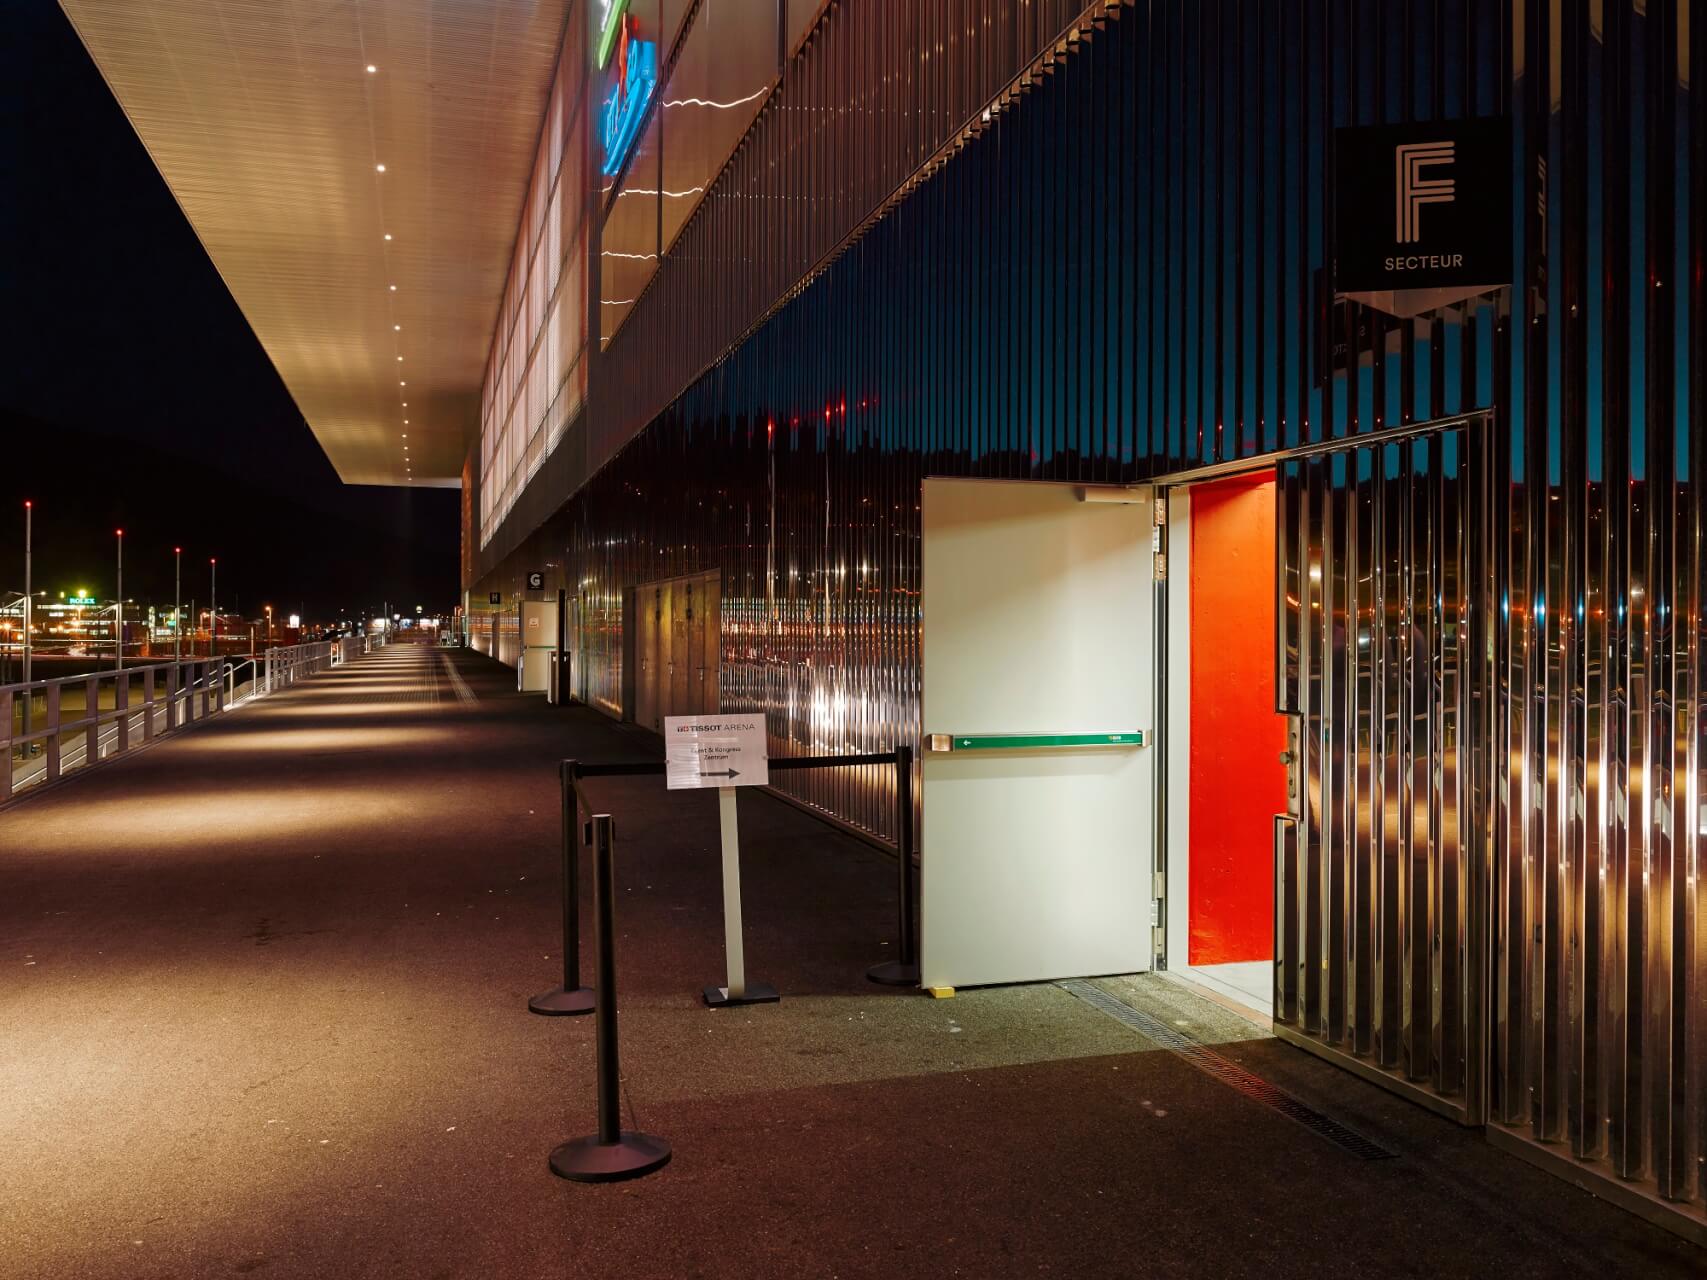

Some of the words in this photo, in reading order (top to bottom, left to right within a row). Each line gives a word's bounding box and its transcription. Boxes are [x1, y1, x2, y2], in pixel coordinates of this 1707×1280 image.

[1396, 141, 1456, 243] F
[1384, 254, 1464, 271] SECTEUR
[530, 573, 541, 586] G
[723, 723, 756, 731] ARENA
